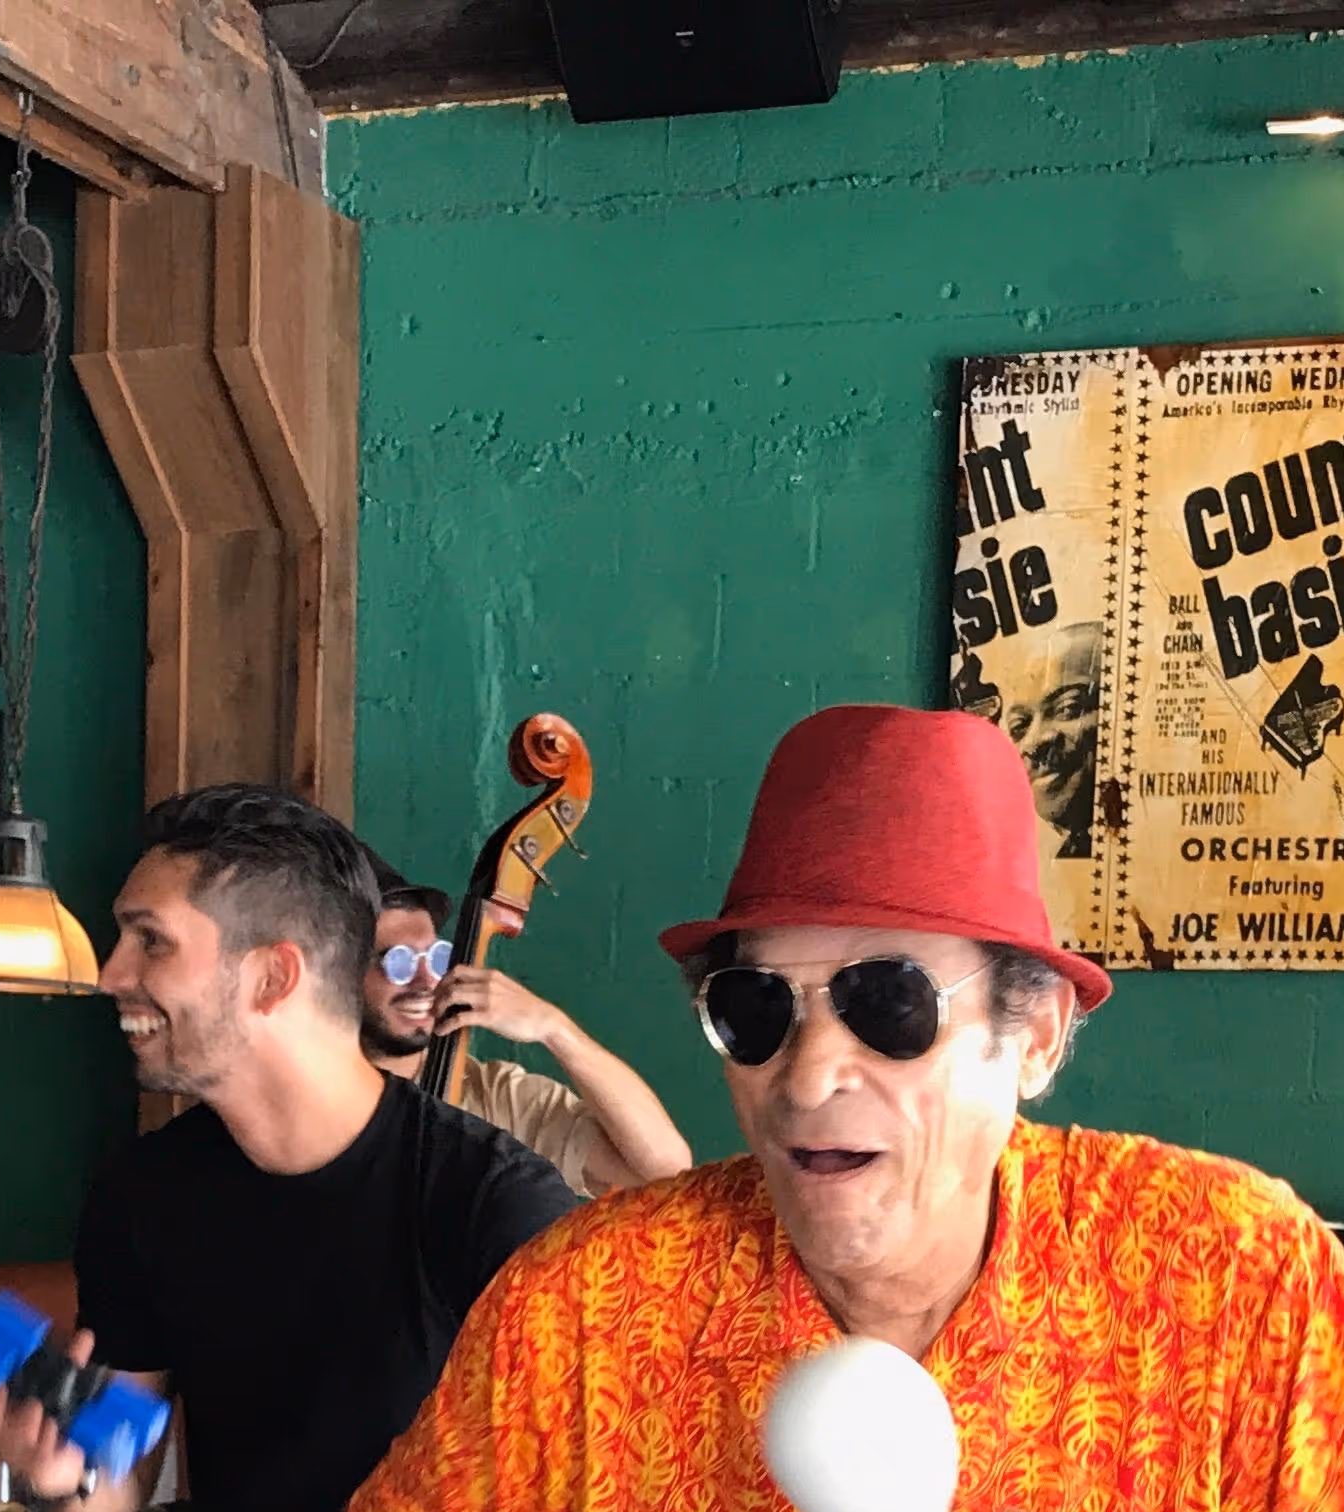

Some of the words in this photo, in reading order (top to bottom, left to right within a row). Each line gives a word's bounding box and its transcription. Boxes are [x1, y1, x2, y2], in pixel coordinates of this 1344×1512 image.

[1177, 369, 1272, 396] OPENING
[1169, 594, 1201, 614] BALL
[1163, 634, 1203, 654] CHAIN
[1200, 728, 1227, 744] AND
[1202, 750, 1224, 764] HIS
[1139, 771, 1279, 797] INTERNATIONALLY
[1181, 802, 1245, 826] FAMOUS
[1229, 874, 1324, 900] Featuring
[1168, 913, 1219, 942] JOE
